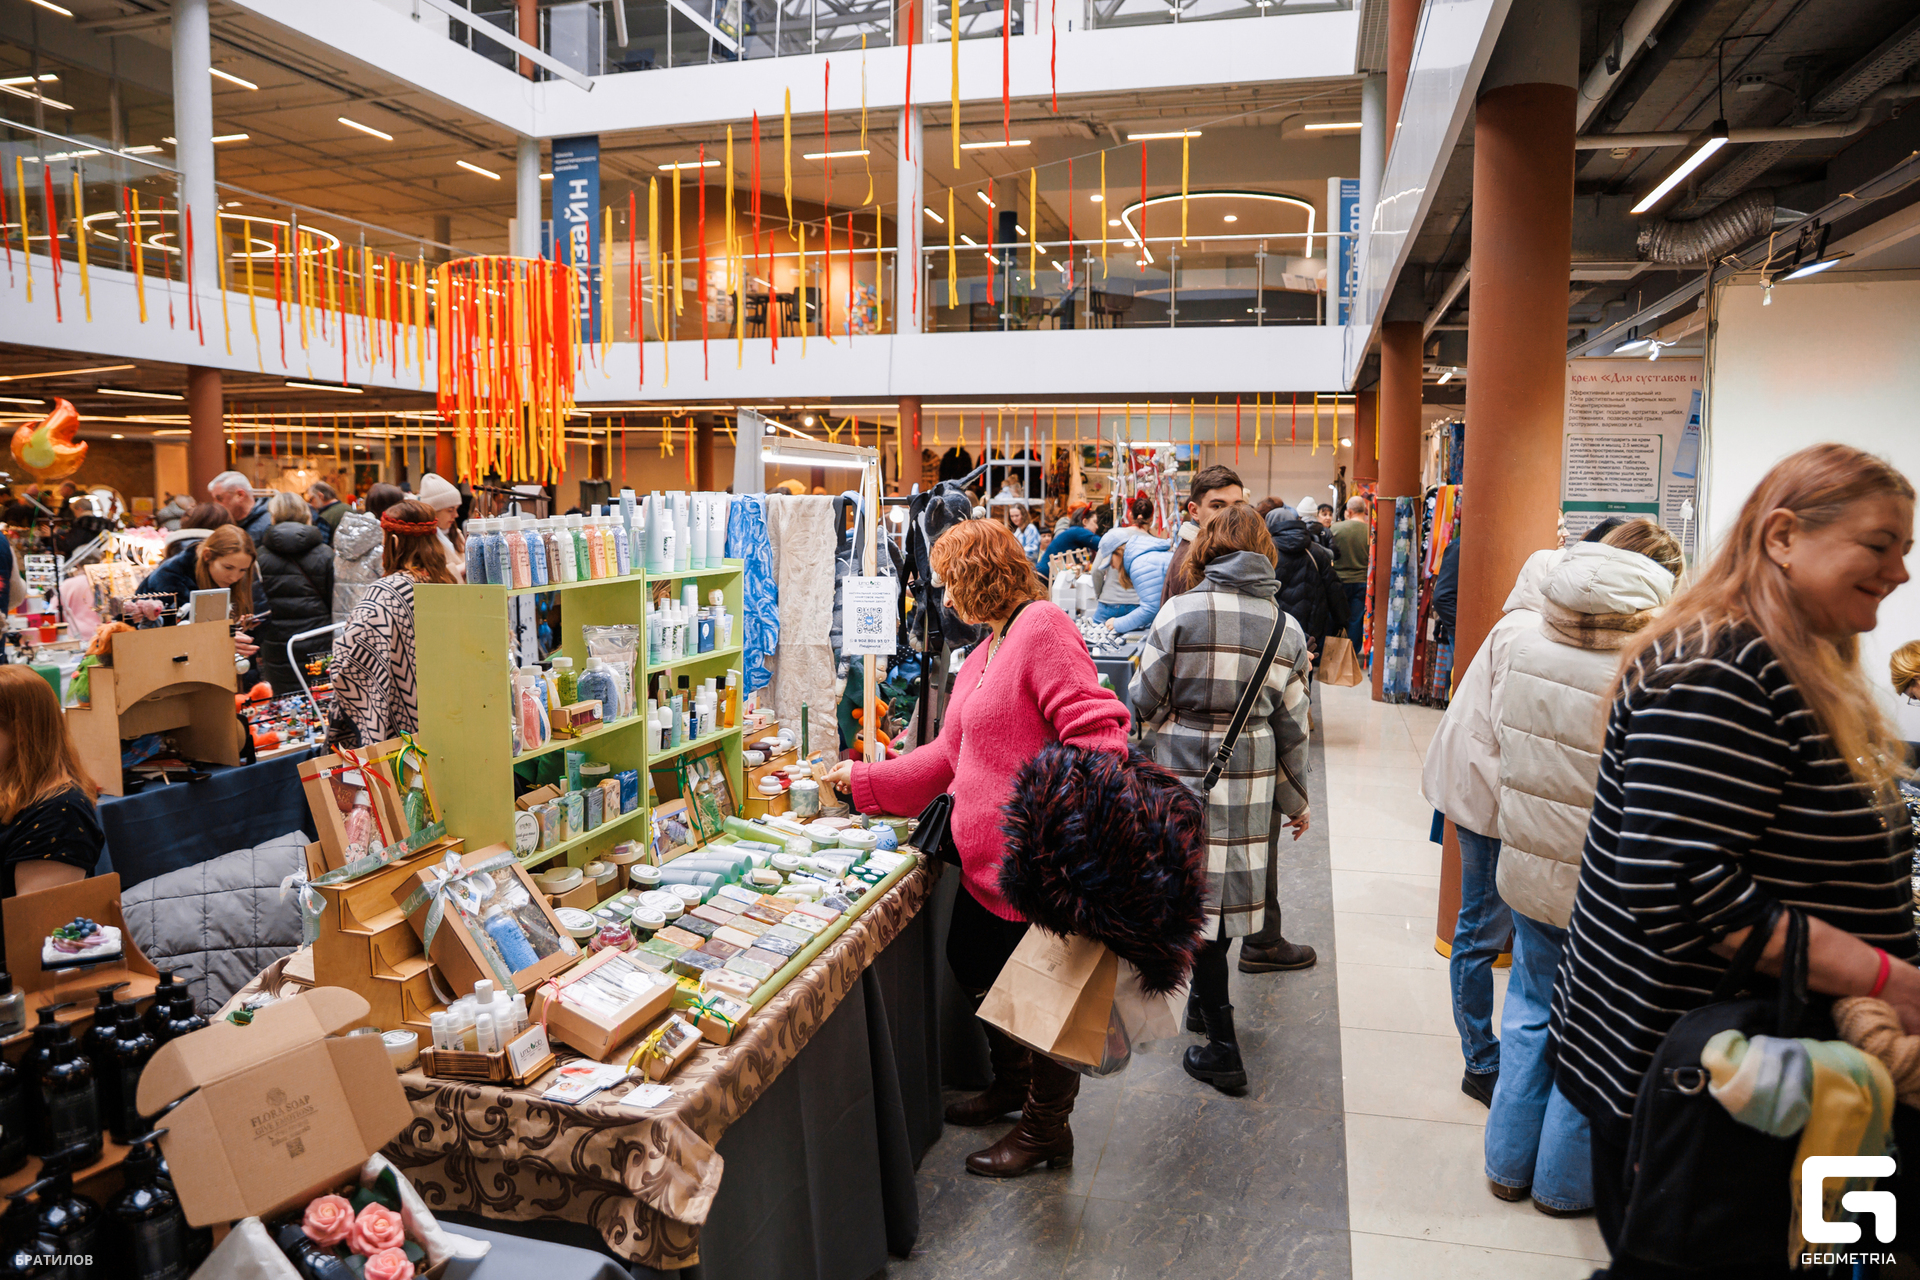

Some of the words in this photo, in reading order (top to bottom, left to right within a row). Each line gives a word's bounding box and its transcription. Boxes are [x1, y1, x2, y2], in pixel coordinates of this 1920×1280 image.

[1572, 375, 1597, 384] крем
[1601, 373, 1632, 383] «Для
[1635, 374, 1686, 385] суставов
[251, 1108, 285, 1127] FLORA
[286, 1094, 310, 1112] SOAP
[255, 1123, 274, 1136] GIVE
[275, 1105, 314, 1126] EMOTIONS
